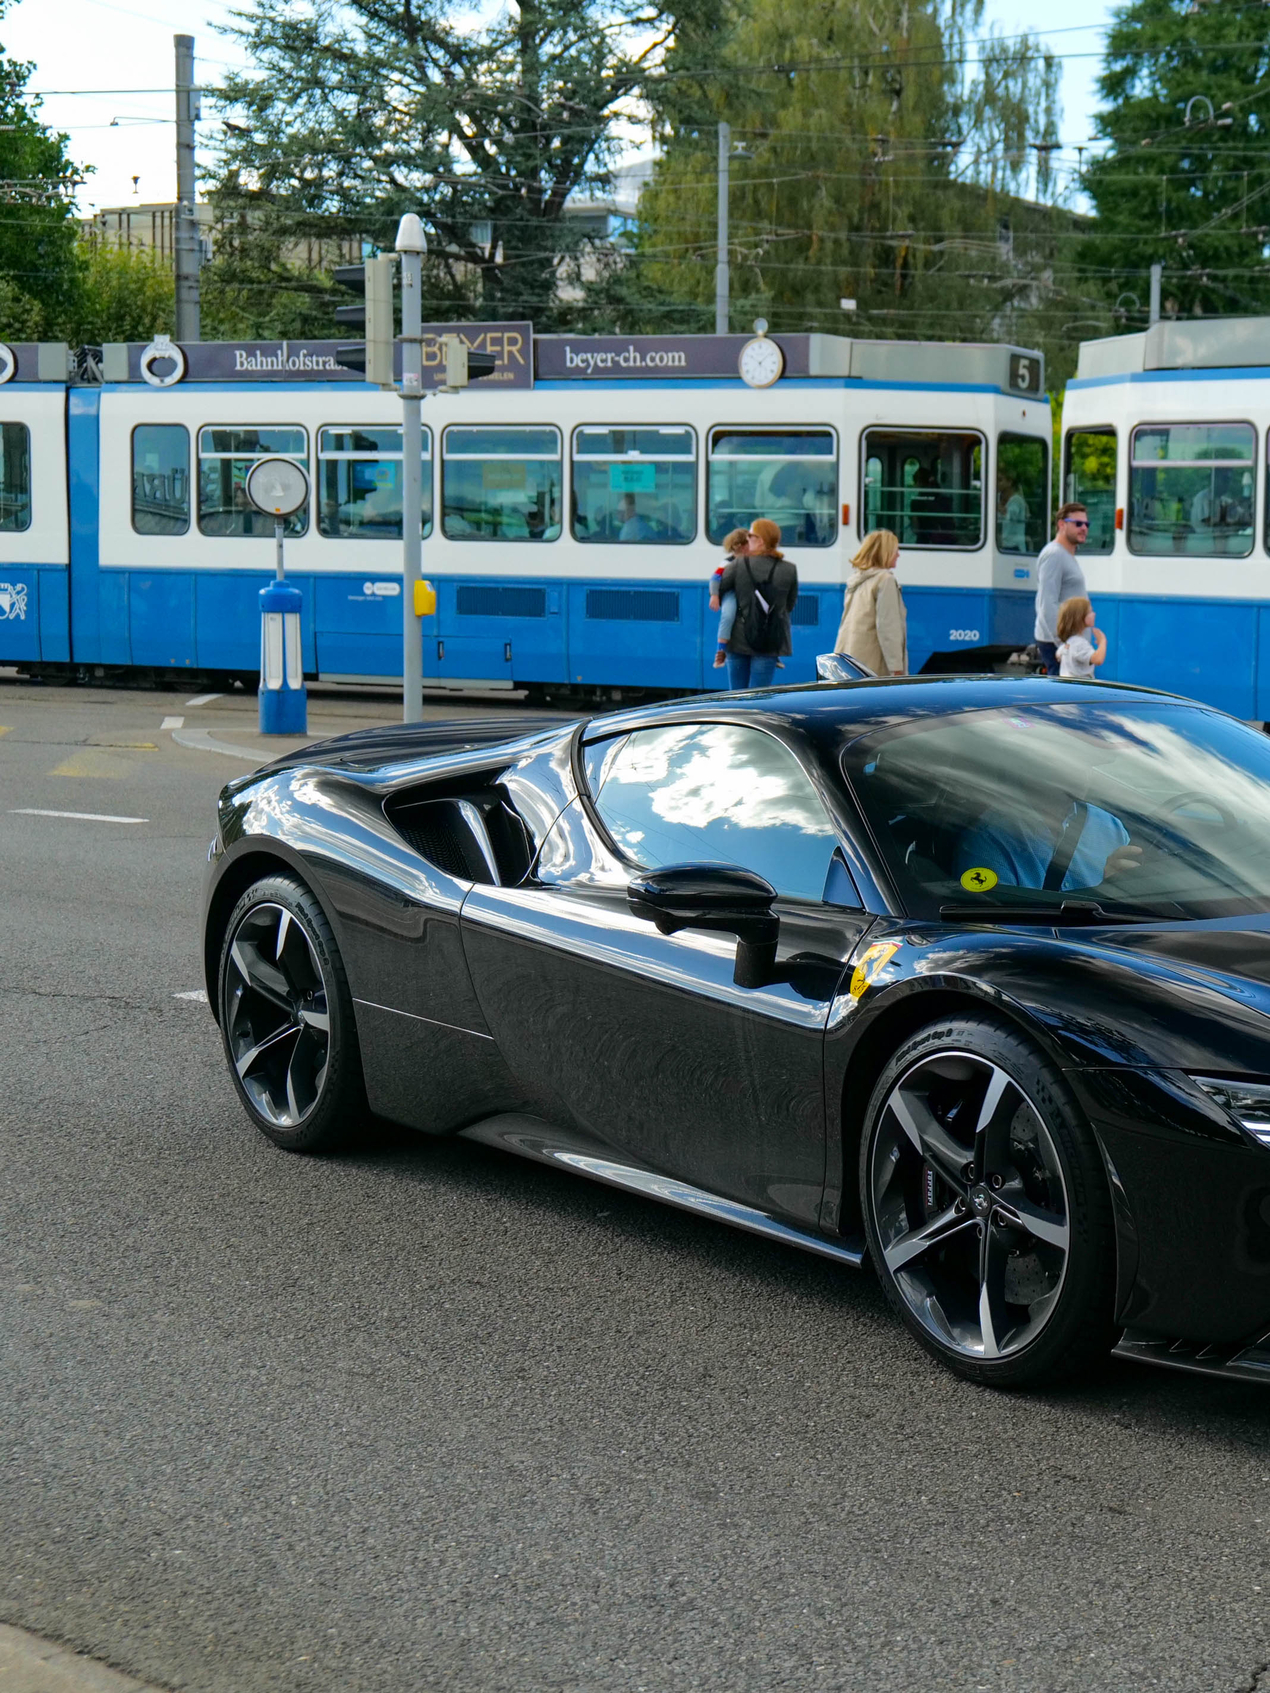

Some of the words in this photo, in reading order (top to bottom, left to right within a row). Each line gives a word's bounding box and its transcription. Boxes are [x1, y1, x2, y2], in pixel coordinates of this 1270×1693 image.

[234, 349, 348, 371] Bahnhofstra
[565, 345, 686, 374] beyer-ch.com
[1017, 358, 1030, 390] 5
[949, 629, 980, 641] 2020
